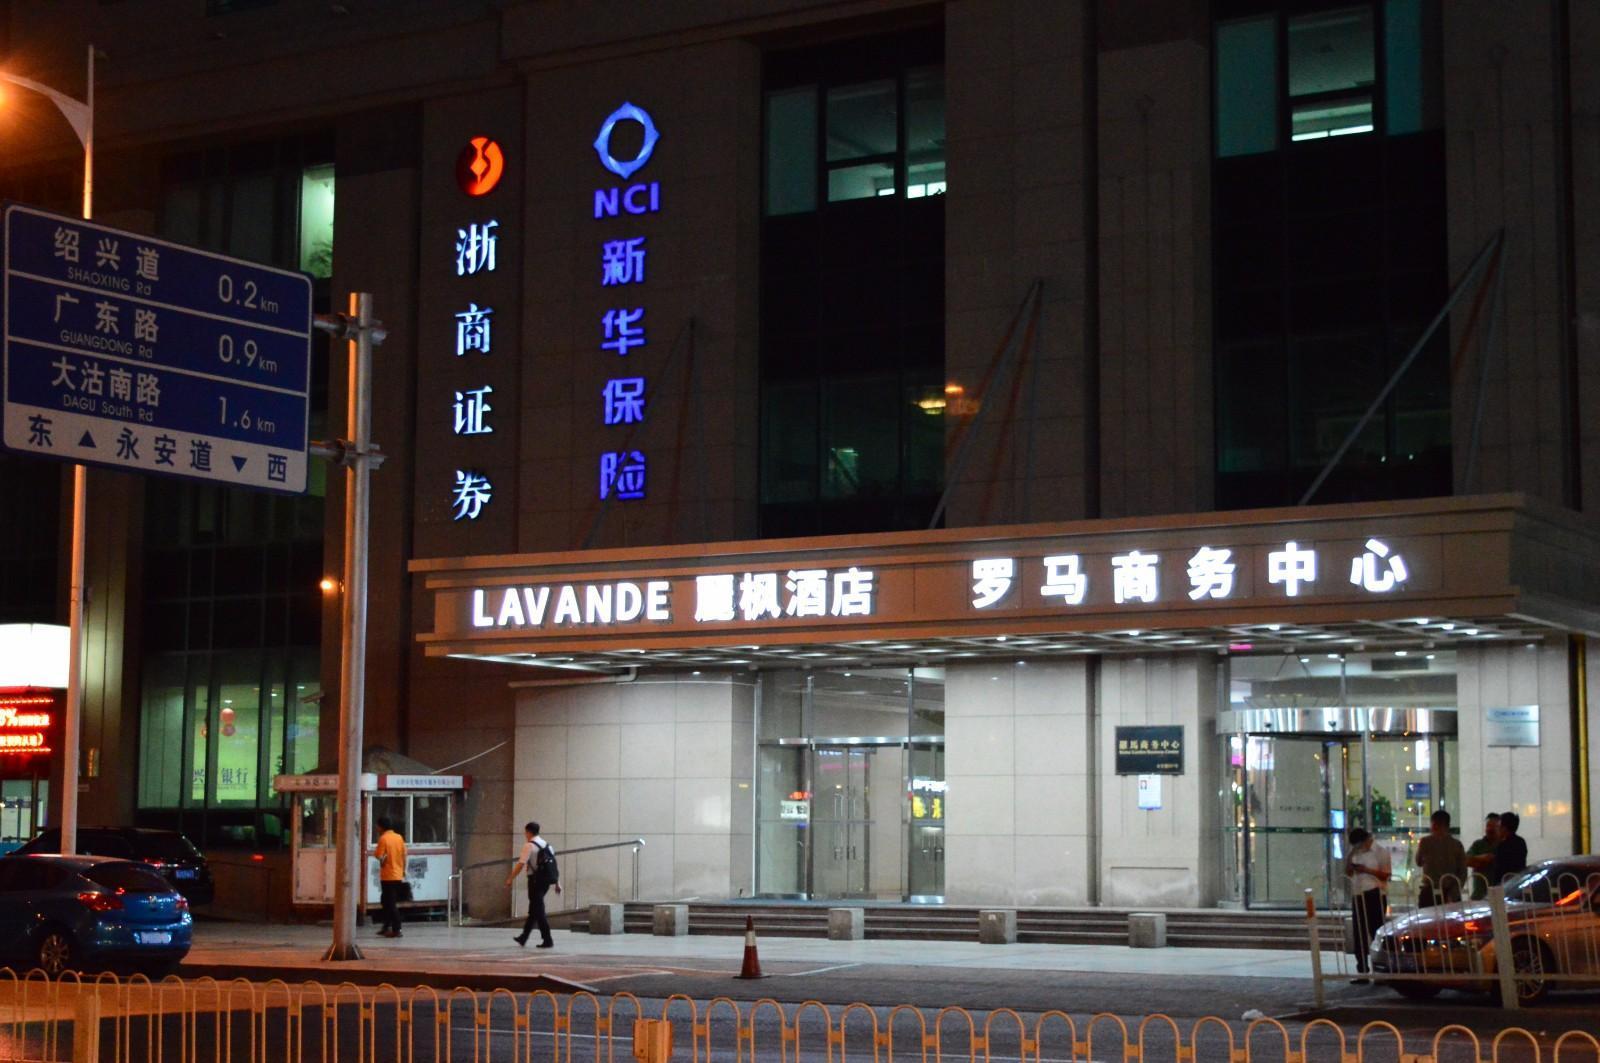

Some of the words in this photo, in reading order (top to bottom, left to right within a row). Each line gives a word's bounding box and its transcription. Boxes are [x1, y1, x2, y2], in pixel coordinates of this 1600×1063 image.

[592, 182, 660, 219] NCI
[54, 226, 160, 281] 绍兴道
[67, 266, 130, 291] SHAOXING
[136, 283, 152, 296] Rd
[53, 292, 158, 343] 广东路
[60, 330, 133, 356] GUANGDONG
[138, 345, 153, 359] Rd
[452, 219, 499, 521] 浙商证券
[600, 236, 646, 500] 新华保险
[52, 356, 161, 407] 大沽南路
[63, 394, 96, 412] DAGU
[101, 401, 133, 419] South
[138, 408, 153, 422] Rd
[27, 414, 53, 448] 东
[117, 427, 212, 472] 永安道
[267, 453, 288, 483] 西
[971, 537, 1408, 609] 罗马商务中心
[472, 580, 670, 627] LAVANDE
